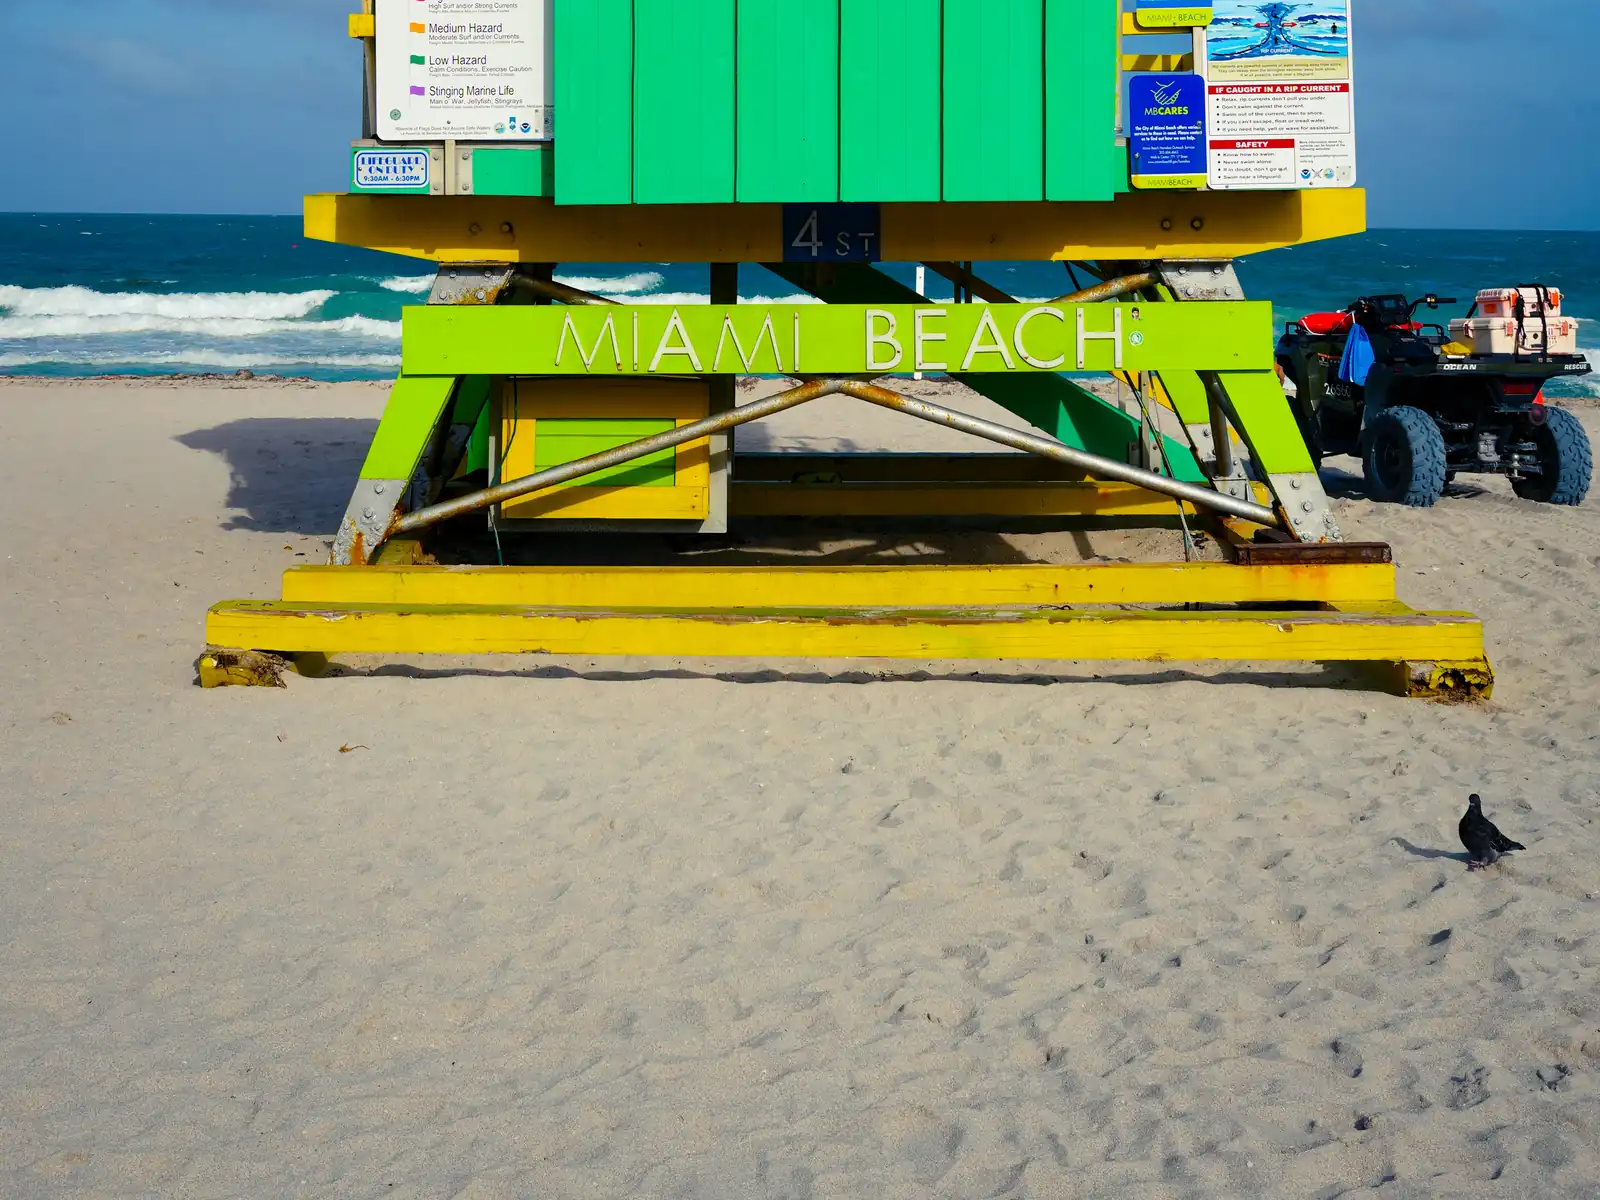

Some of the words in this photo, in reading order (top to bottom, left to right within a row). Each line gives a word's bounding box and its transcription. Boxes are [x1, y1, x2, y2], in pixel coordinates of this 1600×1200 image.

[429, 24, 465, 32] Medium
[469, 24, 502, 32] Hazard
[429, 55, 449, 65] Low
[452, 55, 487, 65] Hazard
[429, 86, 464, 98] Stinging
[466, 86, 496, 95] Marine
[499, 86, 514, 95] Life
[1144, 106, 1188, 115] MBCARES
[361, 157, 422, 165] LIFEGUARD
[368, 166, 383, 174] ON
[386, 166, 414, 174] DUTY
[792, 210, 823, 256] 4
[836, 232, 874, 256] ST
[555, 307, 800, 372] MIAMI
[866, 306, 1123, 370] BEACH
